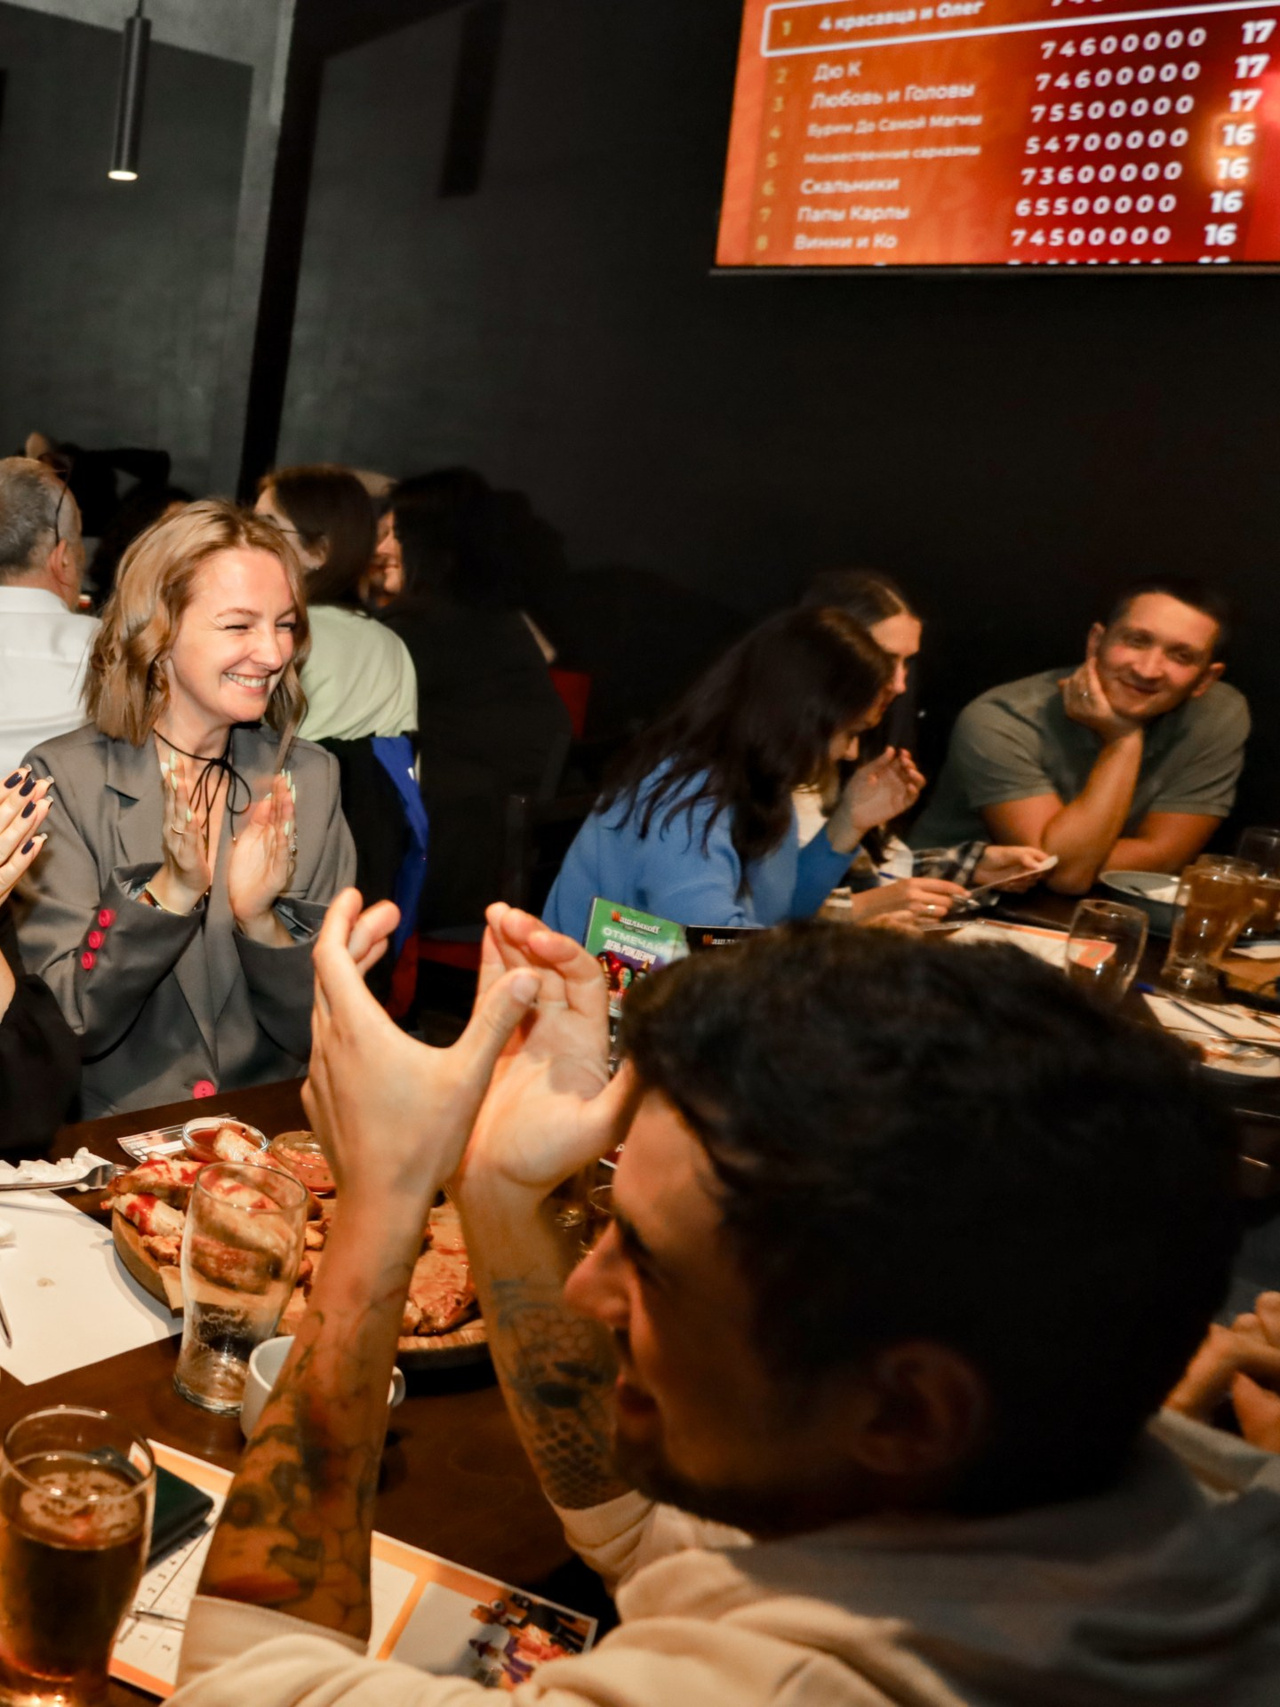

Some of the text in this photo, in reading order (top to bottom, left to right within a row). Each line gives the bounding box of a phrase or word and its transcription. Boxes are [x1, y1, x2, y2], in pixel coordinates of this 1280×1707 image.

[819, 17, 832, 30] 4
[834, 8, 917, 32] красавца
[920, 7, 933, 20] и
[937, 1, 985, 18] Олег
[813, 63, 843, 82] Дю
[847, 61, 862, 77] К
[1241, 19, 1277, 45] 17
[810, 89, 883, 110] Любовь
[887, 90, 900, 103] и
[904, 83, 976, 102] Головы
[1235, 54, 1270, 79] 17
[854, 119, 875, 134] До
[878, 114, 927, 132] Самой
[1229, 88, 1263, 114] 17
[1222, 123, 1256, 147] 16
[800, 178, 900, 195] Скальники
[1217, 157, 1250, 180] 16
[797, 206, 846, 222] Папы
[849, 206, 910, 223] Карлы
[1209, 190, 1244, 214] 16
[793, 234, 853, 251] Винни
[855, 237, 869, 249] и
[873, 234, 898, 249] Ко
[1204, 223, 1238, 246] 16
